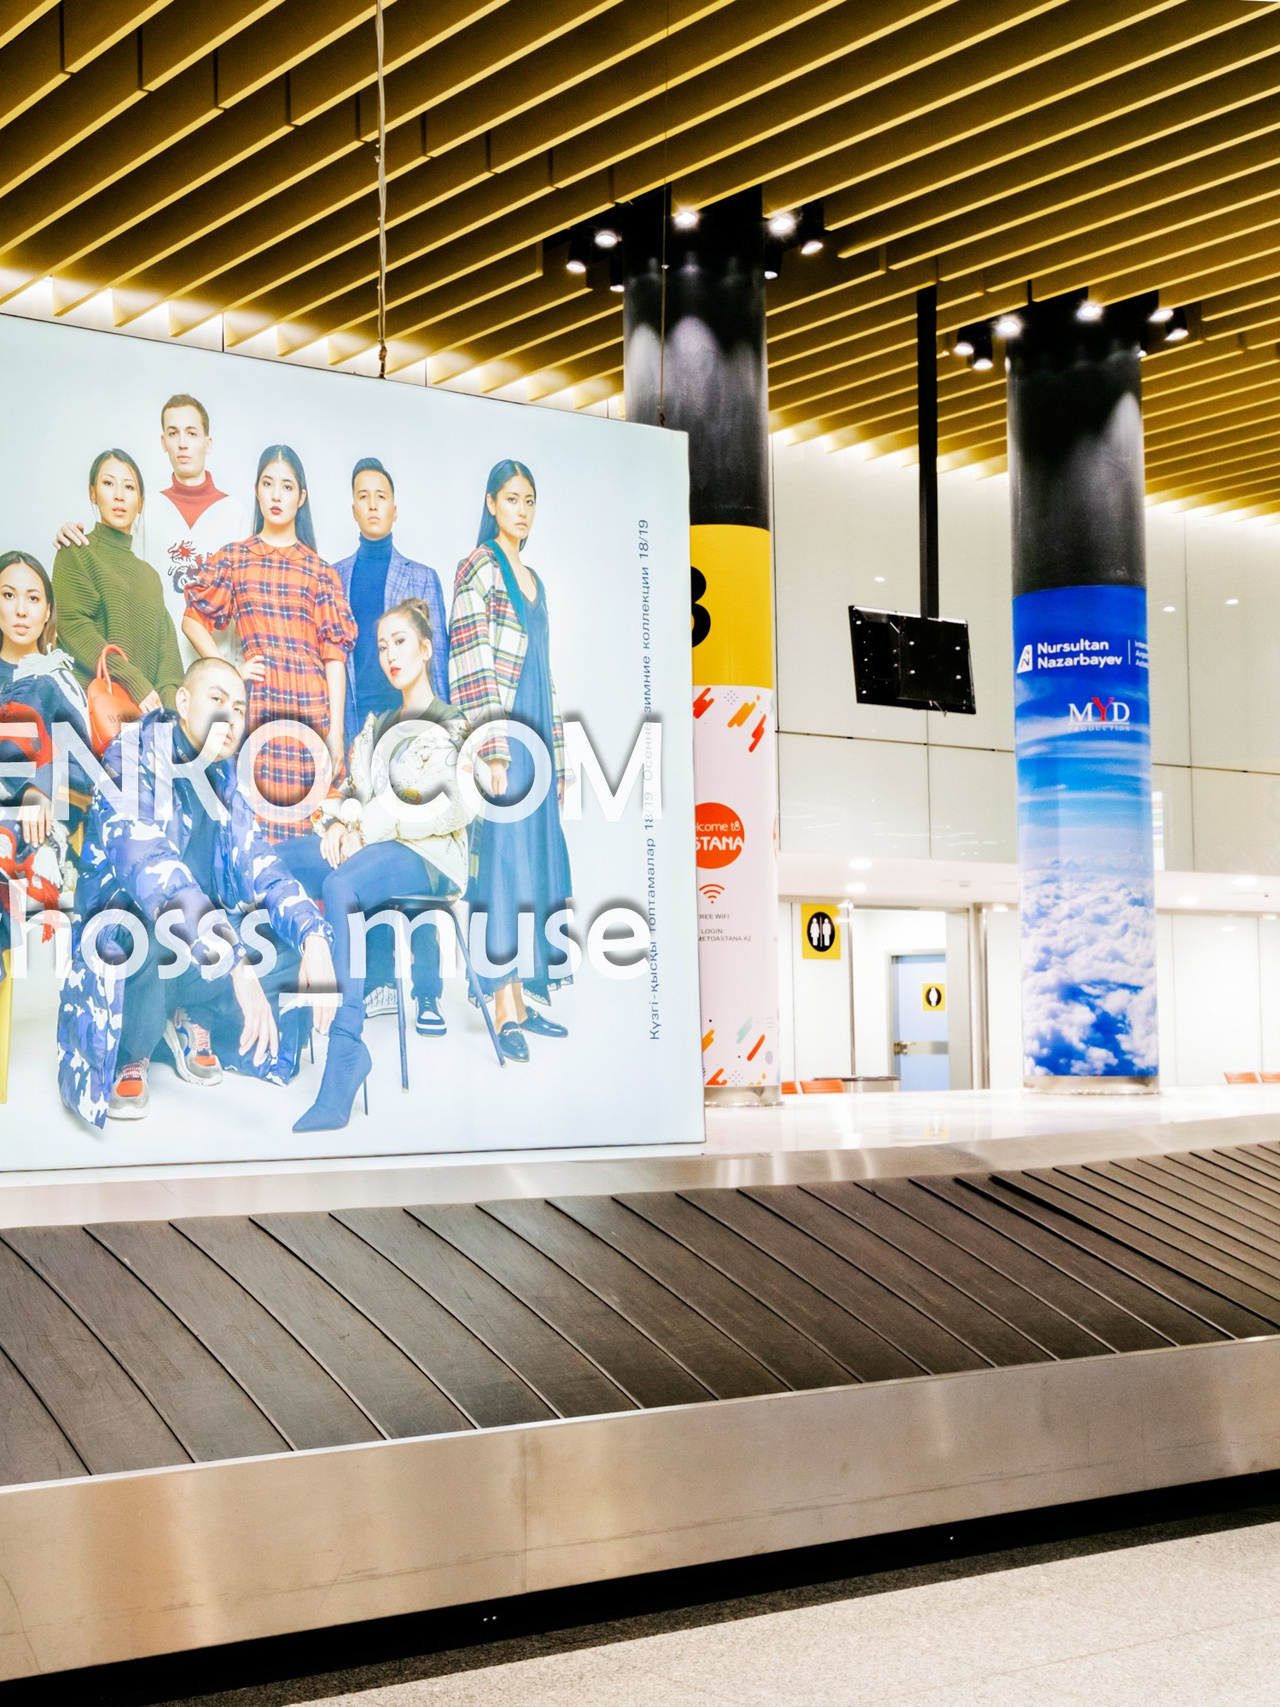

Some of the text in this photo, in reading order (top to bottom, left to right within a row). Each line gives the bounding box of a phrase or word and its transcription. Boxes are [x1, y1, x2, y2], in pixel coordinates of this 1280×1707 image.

[638, 519, 649, 559] 18/19
[641, 567, 651, 649] коллекции
[1038, 638, 1109, 655] Nursultan
[1038, 653, 1123, 669] Nazarbayev
[1068, 697, 1130, 722] MYD
[696, 836, 745, 851] STANA
